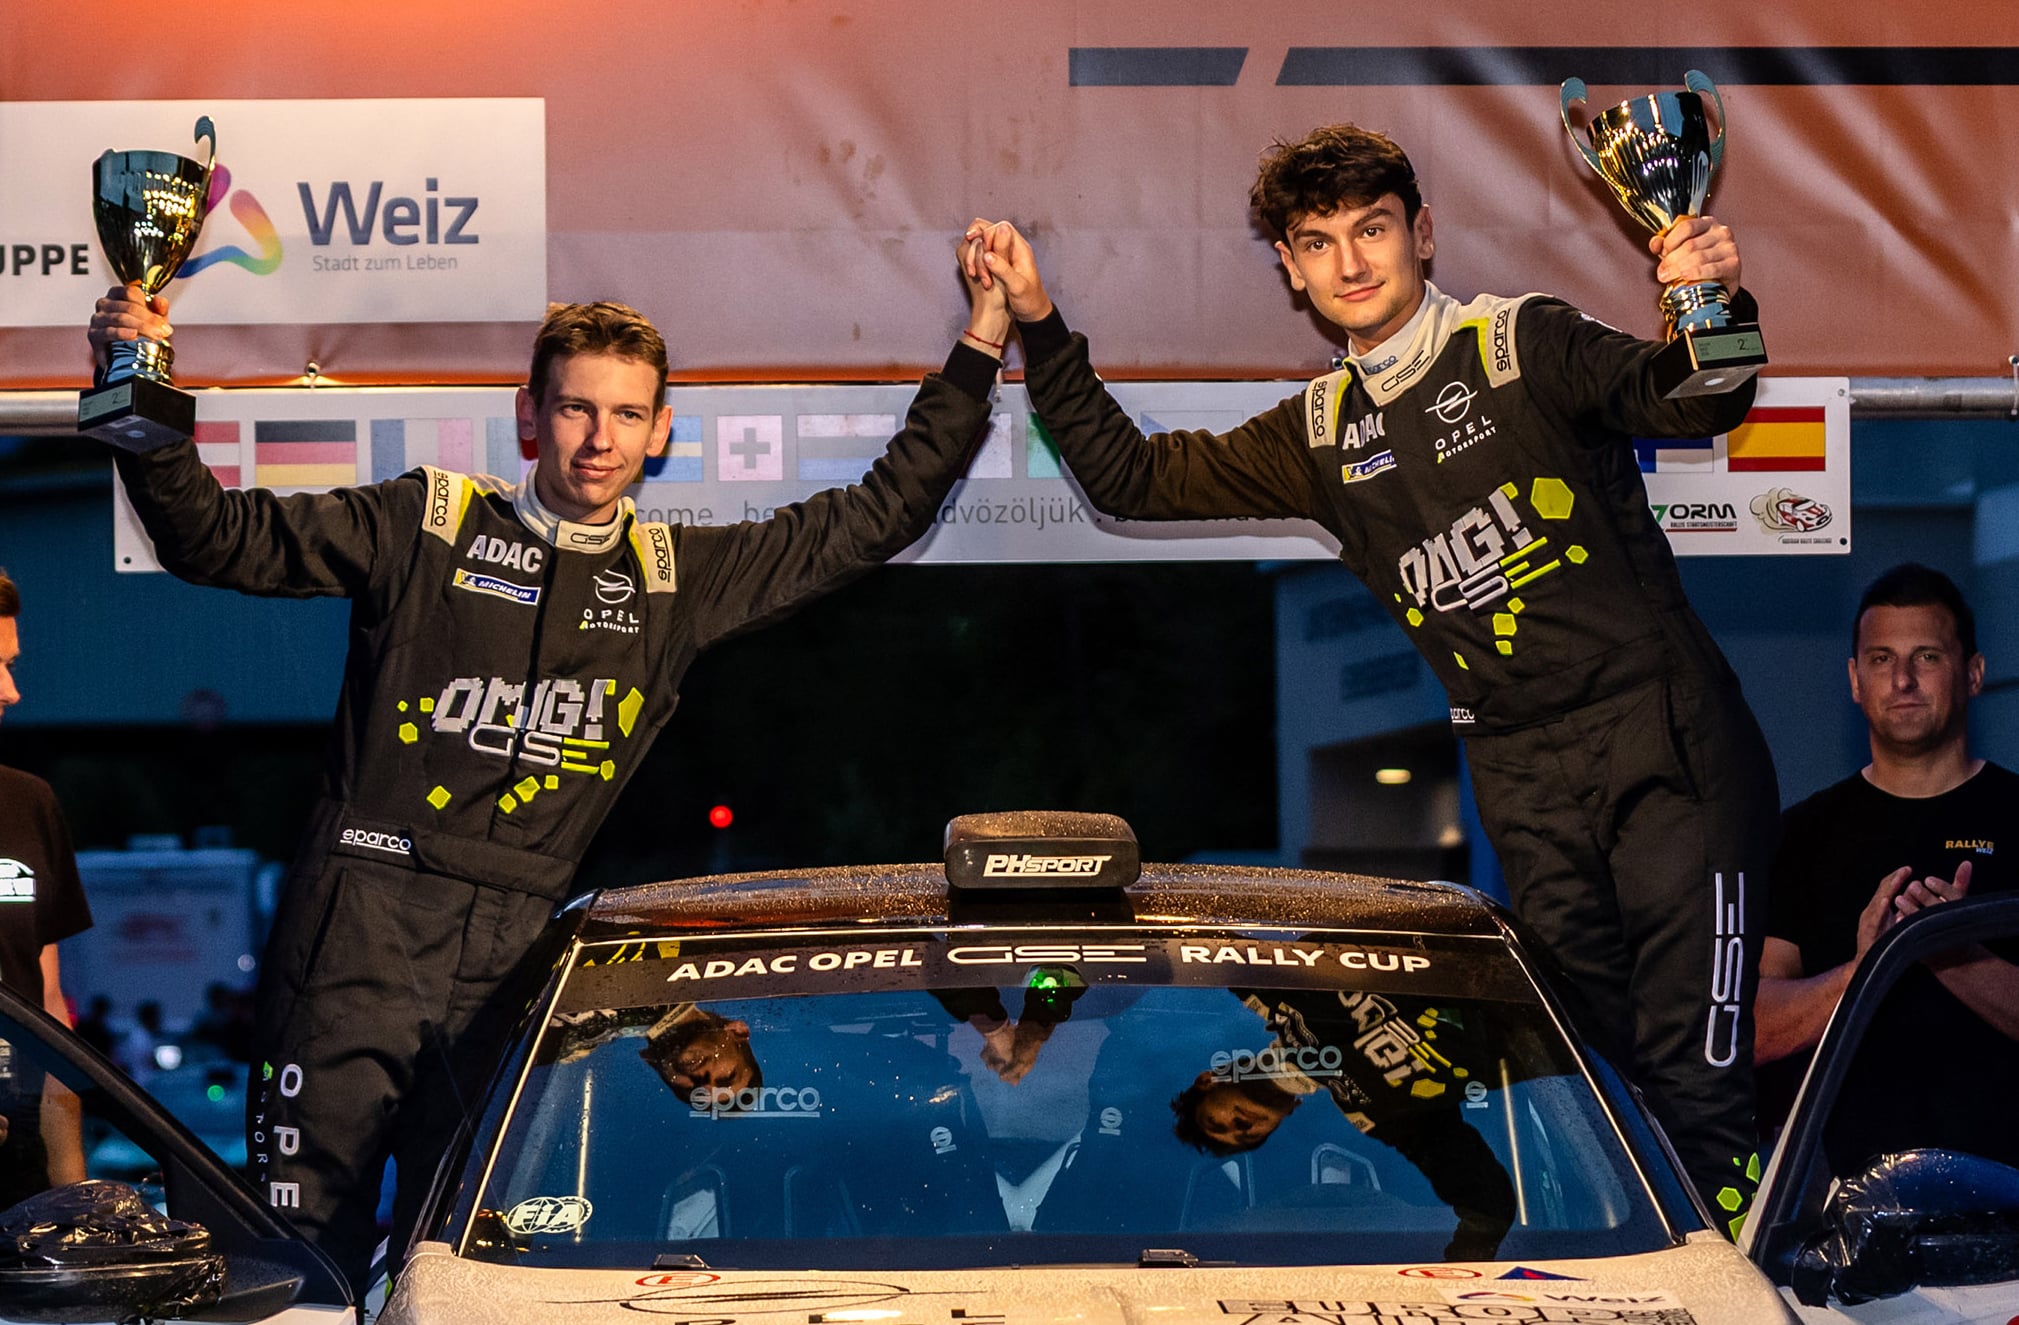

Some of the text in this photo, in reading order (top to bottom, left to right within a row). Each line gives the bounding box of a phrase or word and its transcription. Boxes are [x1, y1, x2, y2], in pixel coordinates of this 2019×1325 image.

[297, 178, 479, 246] Weiz
[0, 244, 89, 275] PPE
[312, 254, 458, 271] Stadt zum Leben
[1494, 308, 1511, 373] sparco
[1311, 381, 1327, 439] sparco
[1435, 415, 1492, 450] OPEL
[1437, 426, 1497, 464] MOTORSPORT
[431, 471, 450, 527] sparco
[1670, 504, 1737, 519] ORM
[466, 535, 543, 573] ADAC
[648, 528, 671, 583] sparco
[478, 580, 532, 599] MICHELIN
[583, 608, 639, 624] OPEL
[340, 829, 411, 855] sparco
[1945, 839, 1994, 849] RALLYE
[667, 955, 797, 981] ADAC
[808, 949, 922, 971] OPEL
[1180, 945, 1325, 966] RALLY
[1338, 951, 1431, 972] CUP
[1210, 1046, 1343, 1082] sparco
[690, 1086, 820, 1120] sparco
[270, 1063, 303, 1207] OPE
